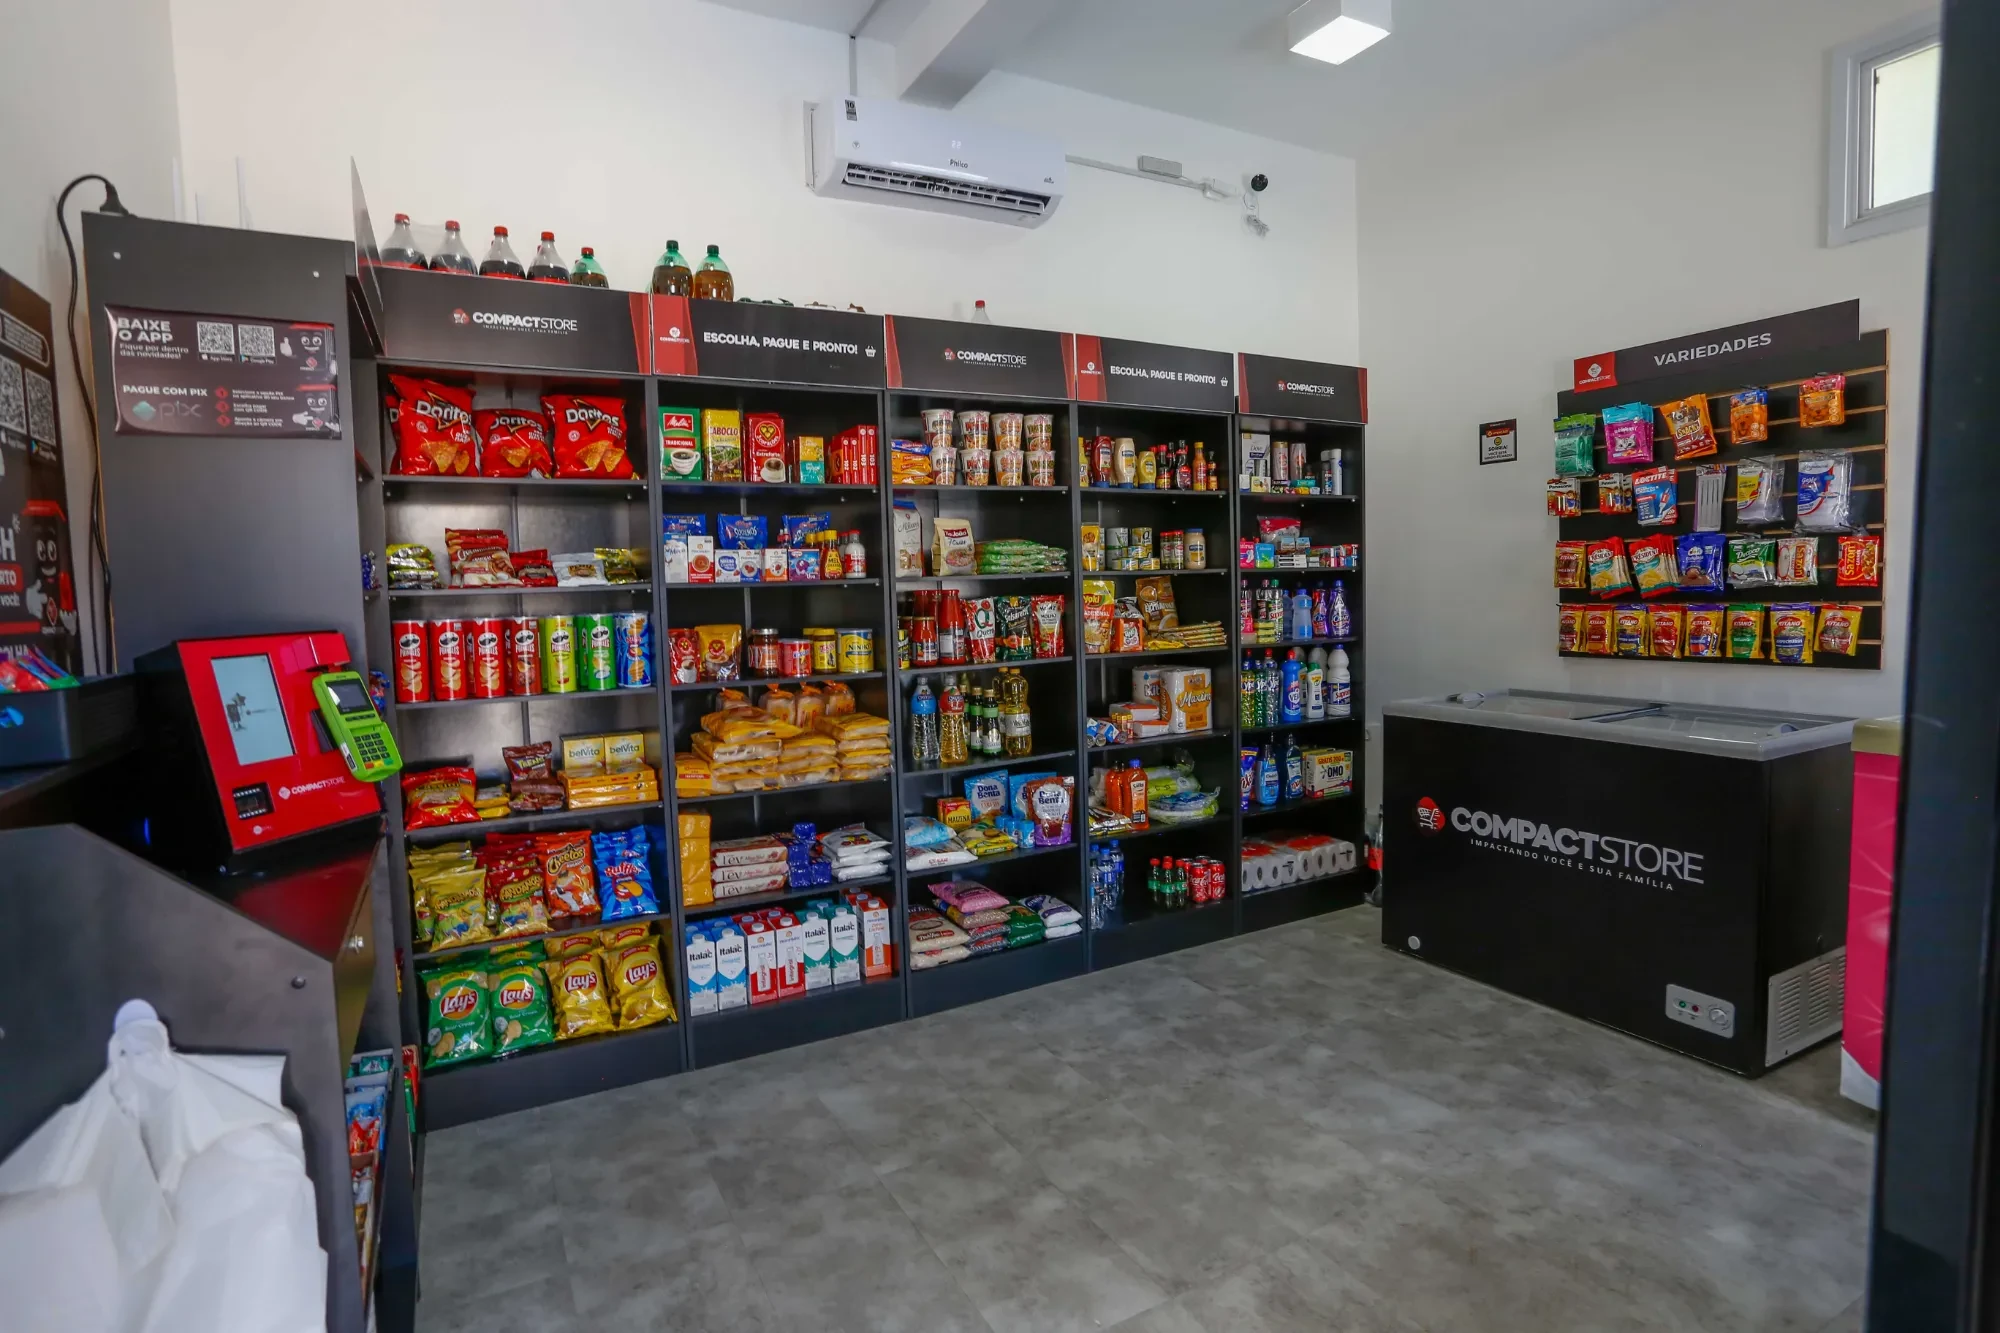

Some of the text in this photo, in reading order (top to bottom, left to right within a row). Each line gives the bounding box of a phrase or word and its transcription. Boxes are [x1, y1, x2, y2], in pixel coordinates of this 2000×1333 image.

[949, 158, 969, 169] Philco
[117, 317, 171, 332] BAIXE
[472, 311, 578, 332] COMPACTSTORE
[119, 330, 174, 344] O APP
[703, 332, 858, 355] ESCOLHA, PAGUE E PRONTO!
[120, 343, 189, 355] Fique por dentro
[1653, 332, 1772, 367] VARIEDADES
[957, 350, 1027, 365] COMPACTSTORE
[1110, 365, 1216, 385] ESCOLHA, PAGUE E PRONTO!
[123, 385, 209, 397] PAGUE COM PIX
[1286, 382, 1335, 395] COMPACTSTORE
[416, 399, 473, 426] Doritos
[565, 408, 619, 428] Doritos
[1634, 473, 1667, 484] LOCTITE
[827, 556, 840, 564] MEL
[806, 572, 816, 580] Uva
[569, 747, 600, 758] belVita
[609, 743, 640, 754] belVita
[1327, 766, 1343, 778] OMO
[291, 776, 346, 796] COMPACTSTORE
[977, 790, 1001, 799] Benta
[1450, 806, 1705, 885] COMPACTSTORE
[547, 848, 586, 874] Cheetos
[1471, 838, 1539, 860] IMPACTANDO
[1543, 854, 1573, 868] VOCÊ
[1589, 866, 1613, 877] SUA
[1618, 871, 1674, 891] FAMÍLIA
[604, 862, 642, 877] Ruffles
[500, 875, 545, 900] FANDANGOS
[805, 926, 826, 938] Italac
[833, 922, 855, 933] Italac
[689, 949, 713, 962] Italac
[719, 944, 743, 956] Italac
[628, 961, 659, 983] Lay's
[567, 972, 597, 990] Lay's
[442, 991, 477, 1013] Lay's
[500, 985, 533, 1006] Lay's
